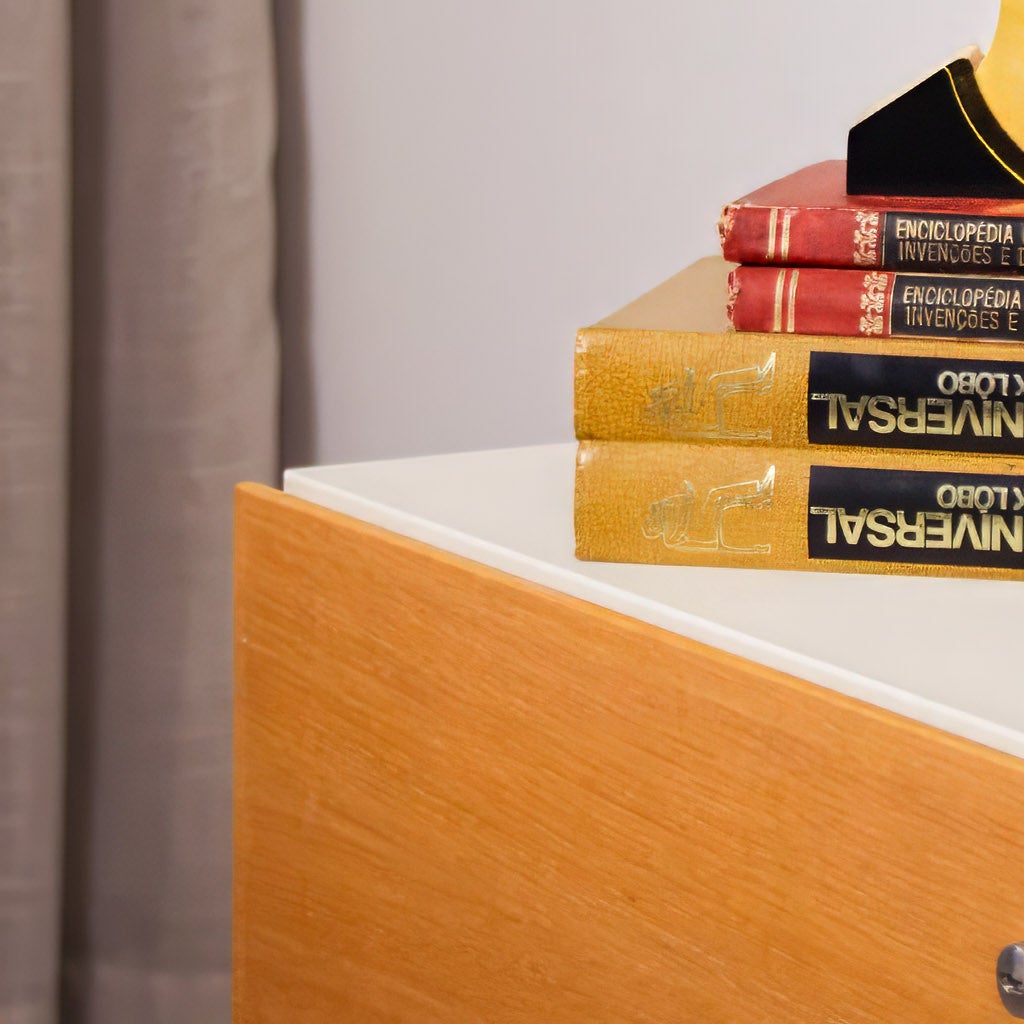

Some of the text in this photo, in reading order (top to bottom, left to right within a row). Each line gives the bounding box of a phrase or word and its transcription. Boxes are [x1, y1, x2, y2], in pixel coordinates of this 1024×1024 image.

[896, 219, 1014, 245] ENCICLOPÉDIA
[1001, 247, 1011, 266] E
[903, 285, 1021, 310] ENCICLOPÉDIA
[906, 306, 1000, 331] INVENÇÕES
[1008, 312, 1018, 332] E
